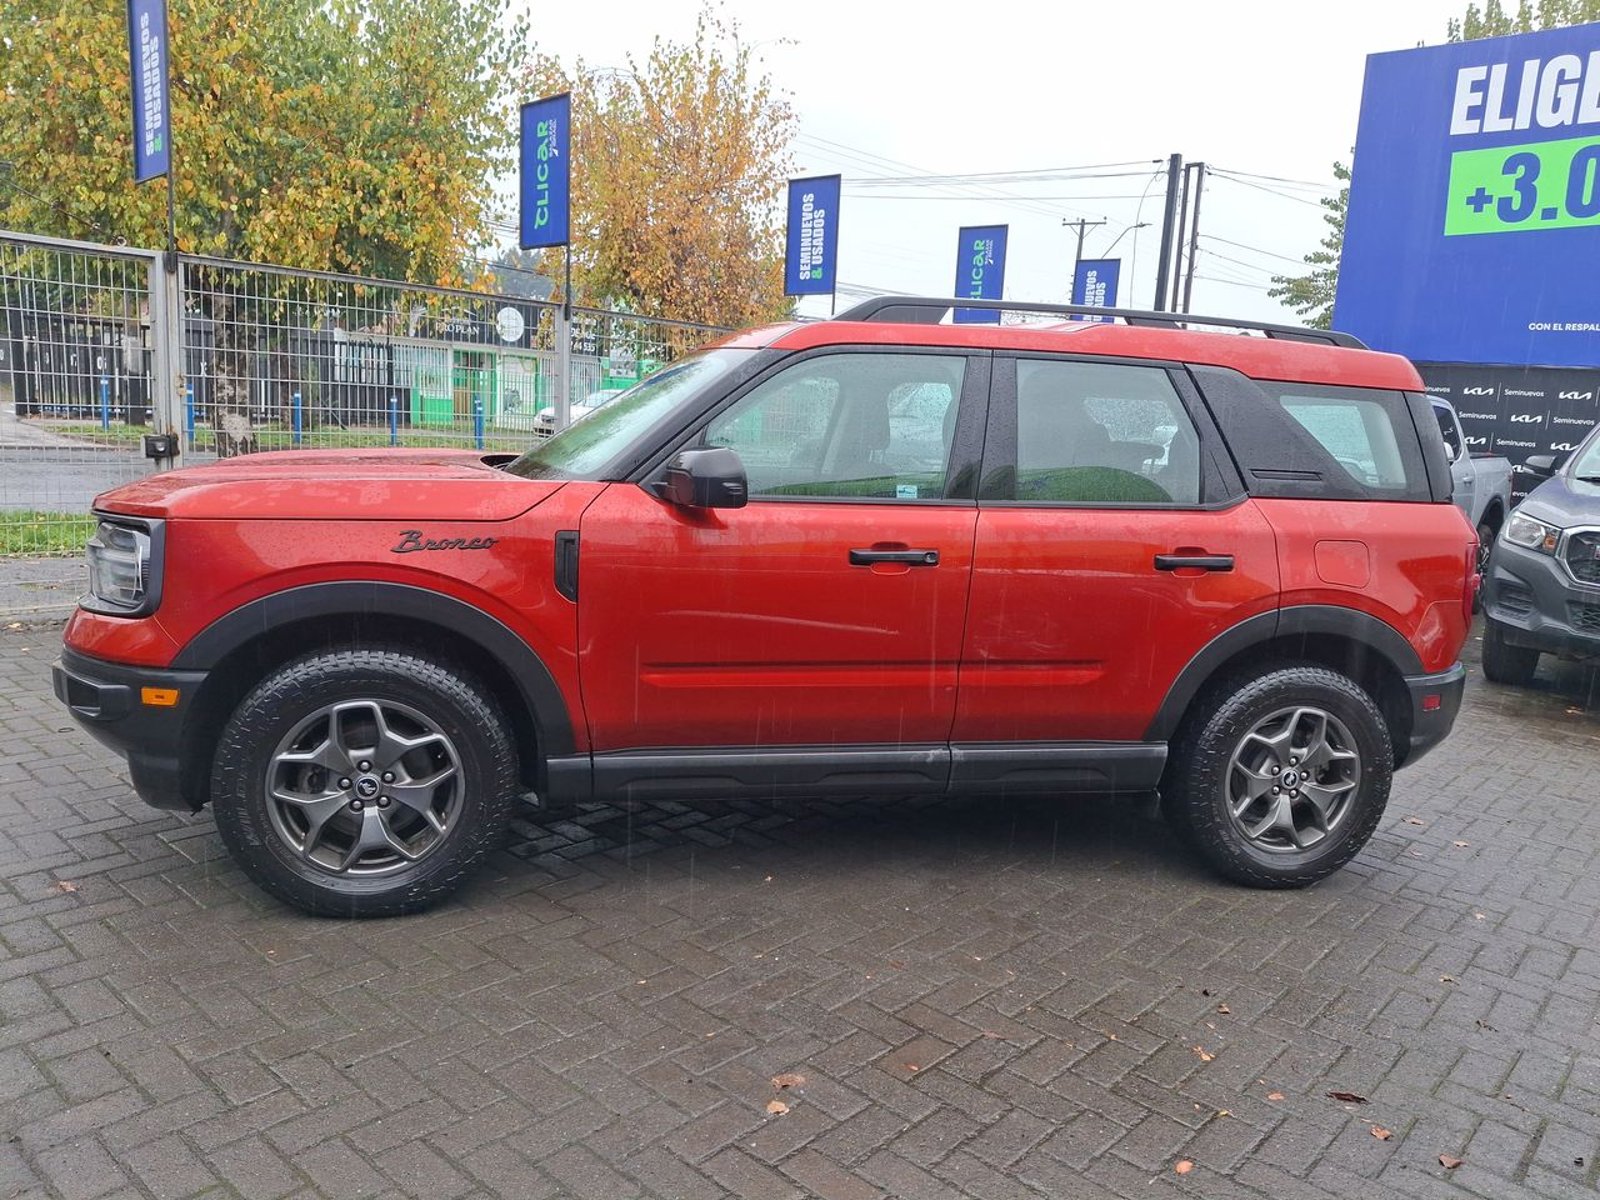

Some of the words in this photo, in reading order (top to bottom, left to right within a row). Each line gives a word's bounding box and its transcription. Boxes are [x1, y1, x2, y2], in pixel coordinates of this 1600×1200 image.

[140, 12, 155, 157] SEMINUEVOS
[150, 36, 162, 129] USADOS
[800, 193, 814, 280] SEMINUEVOS
[812, 209, 825, 265] USADOS
[811, 267, 823, 280] &
[1528, 323, 1551, 331] CON
[1552, 323, 1563, 331] EL
[1463, 387, 1494, 396] KIA
[1504, 388, 1544, 397] Seminuevos
[1559, 391, 1592, 400] KIA
[1459, 411, 1497, 420] Seminuevos
[1510, 414, 1542, 423] KIA
[1553, 416, 1595, 425] Seminuevos
[1496, 439, 1536, 447] Seminuevos
[390, 529, 499, 554] Bronco
